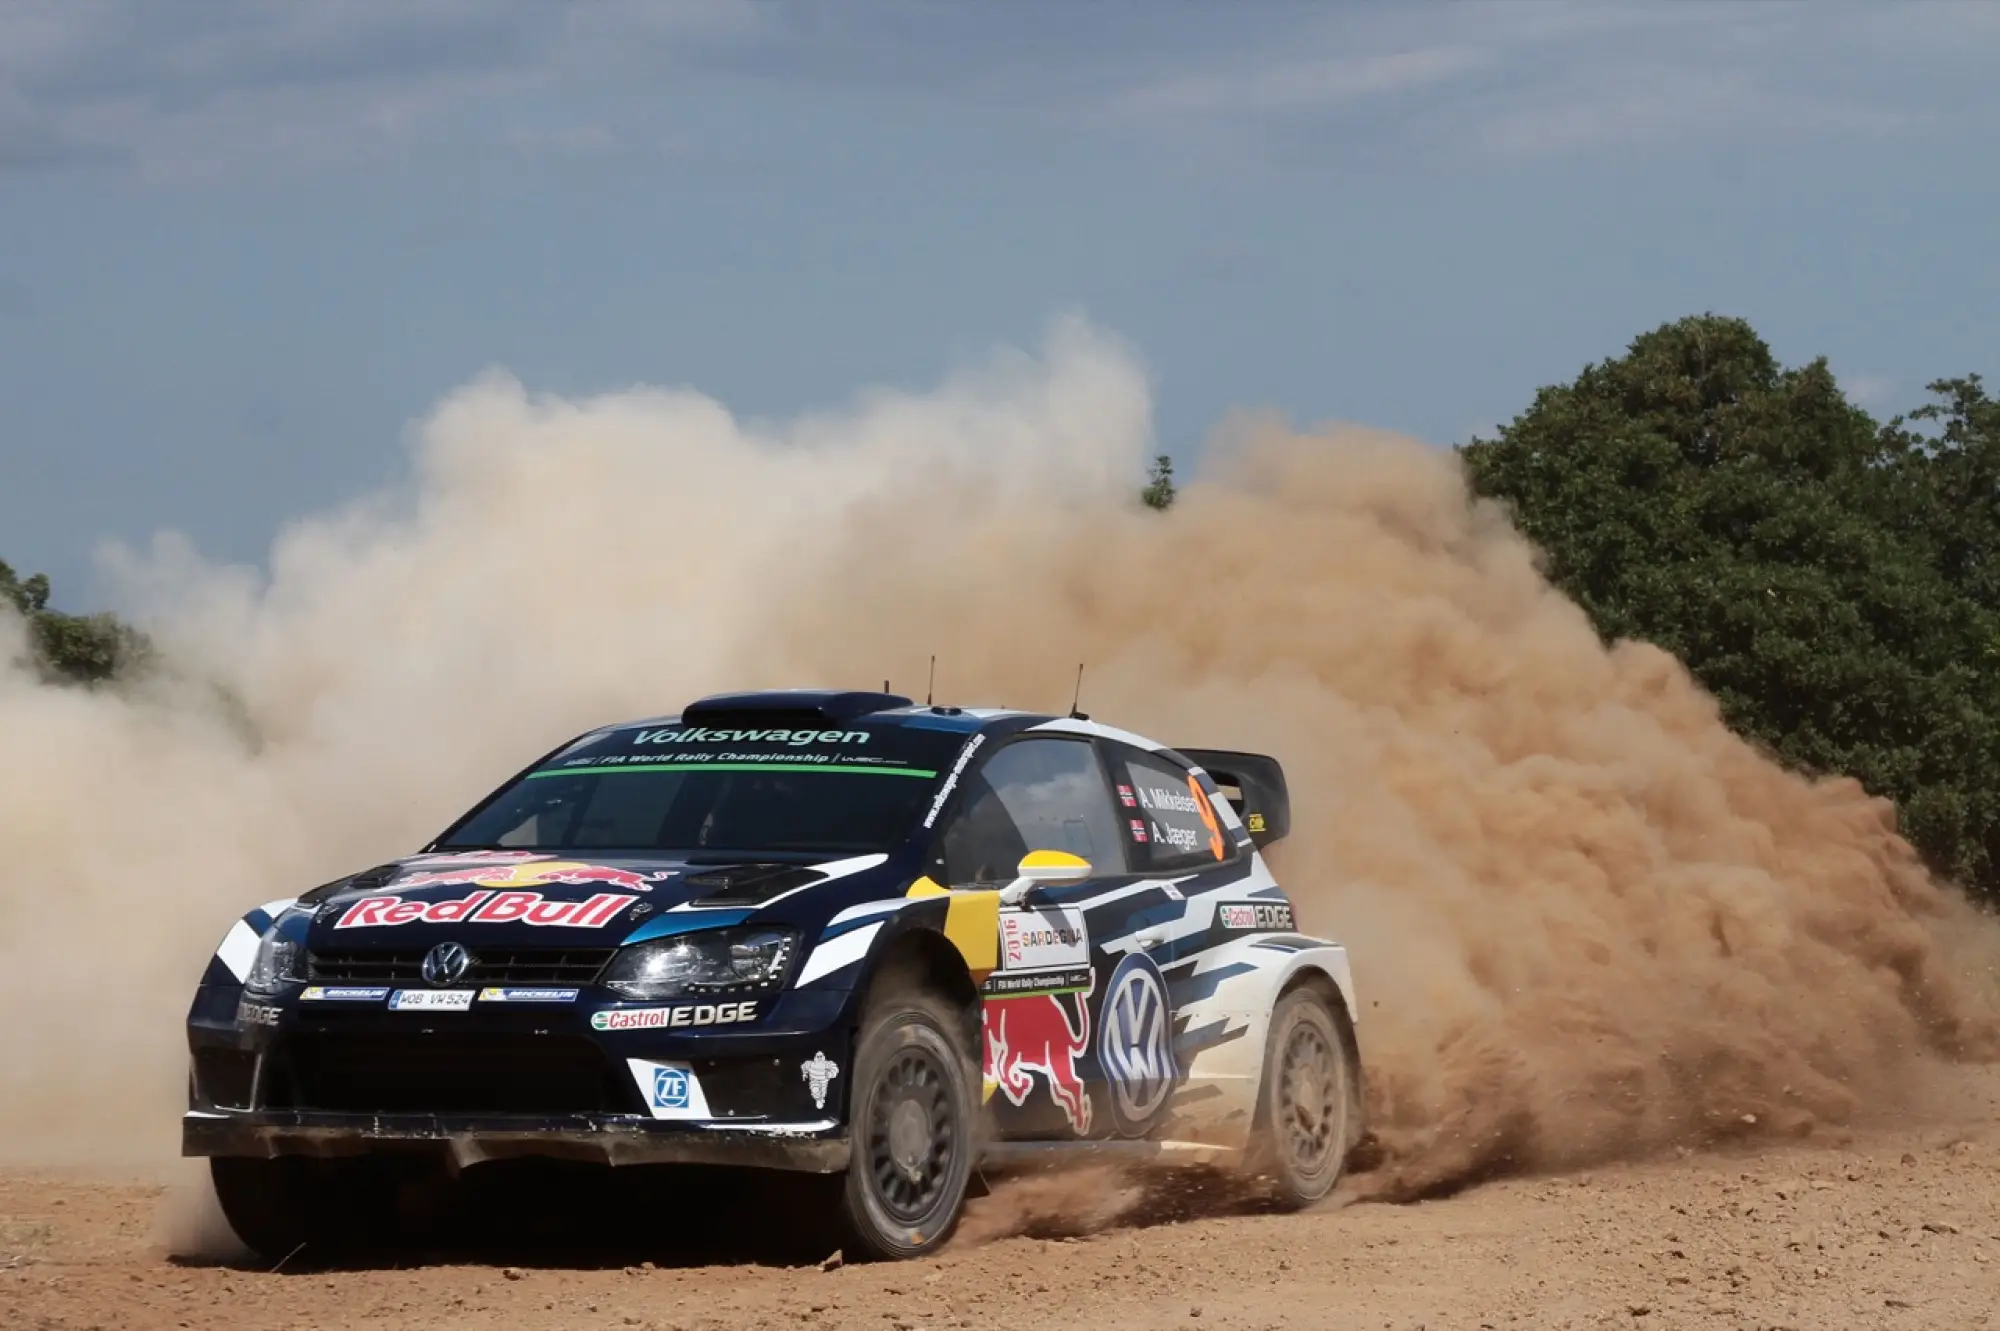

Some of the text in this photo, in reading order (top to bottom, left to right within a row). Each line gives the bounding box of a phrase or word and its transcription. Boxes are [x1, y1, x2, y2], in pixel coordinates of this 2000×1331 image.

[632, 727, 870, 746] Volkswagen
[629, 753, 673, 762] World
[674, 752, 714, 763] Rally
[716, 752, 829, 763] Championship
[1138, 787, 1154, 809] A.
[1187, 774, 1225, 862] 9
[1151, 821, 1166, 844] A.
[334, 891, 639, 929] Red Bull
[1255, 905, 1293, 929] EDGE
[1004, 919, 1022, 962] 2016
[1021, 928, 1083, 947] SARDEGNA
[326, 988, 385, 997] MICHELIN
[509, 989, 576, 998] MICHELIN
[608, 1000, 759, 1029] Castrol EDGE
[659, 1077, 684, 1101] ZF
